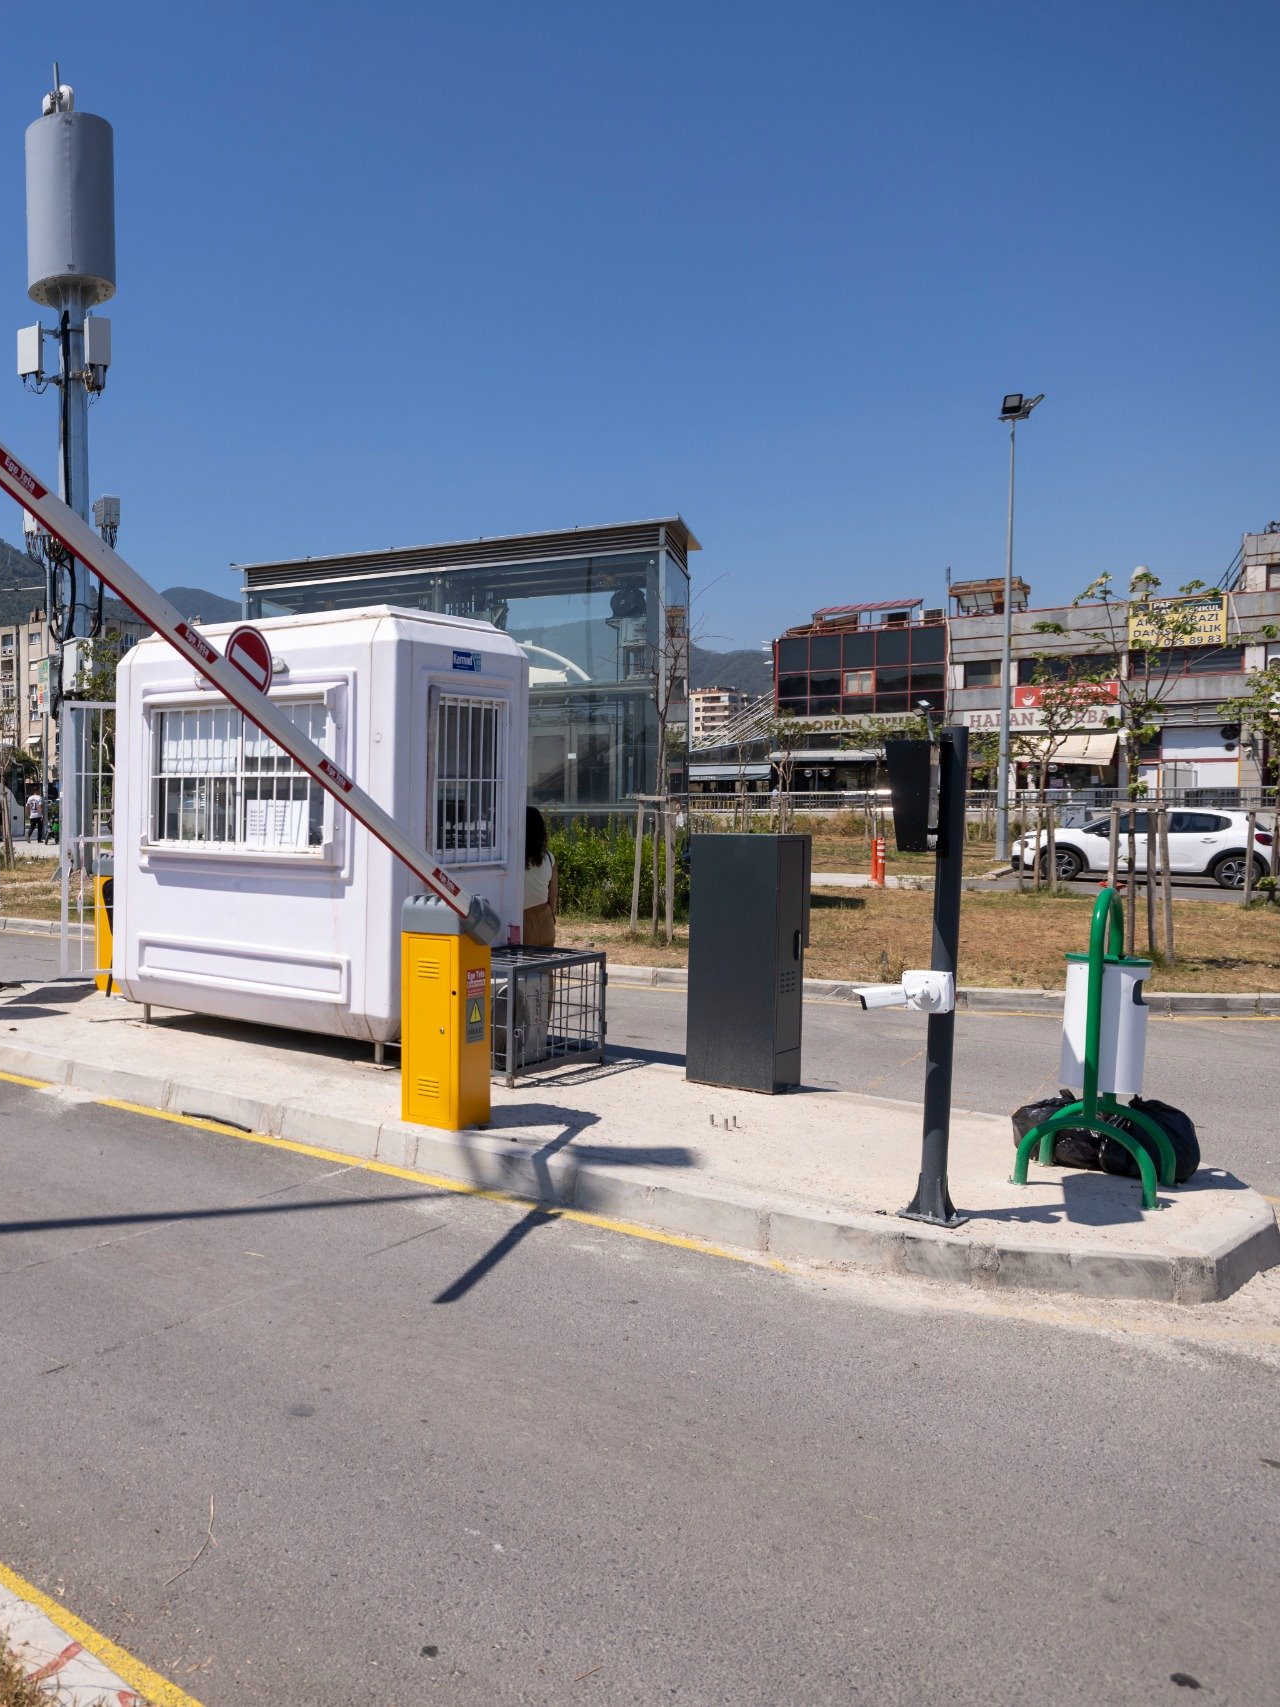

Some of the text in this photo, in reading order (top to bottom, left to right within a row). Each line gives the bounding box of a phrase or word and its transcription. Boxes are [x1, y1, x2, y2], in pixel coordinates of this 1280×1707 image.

[4, 455, 35, 489] Ege Teta
[186, 629, 210, 656] Ege Teta
[1208, 635, 1221, 643] 83
[1051, 709, 1111, 726] ORBA
[327, 764, 336, 777] Ege
[467, 972, 476, 980] Ege
